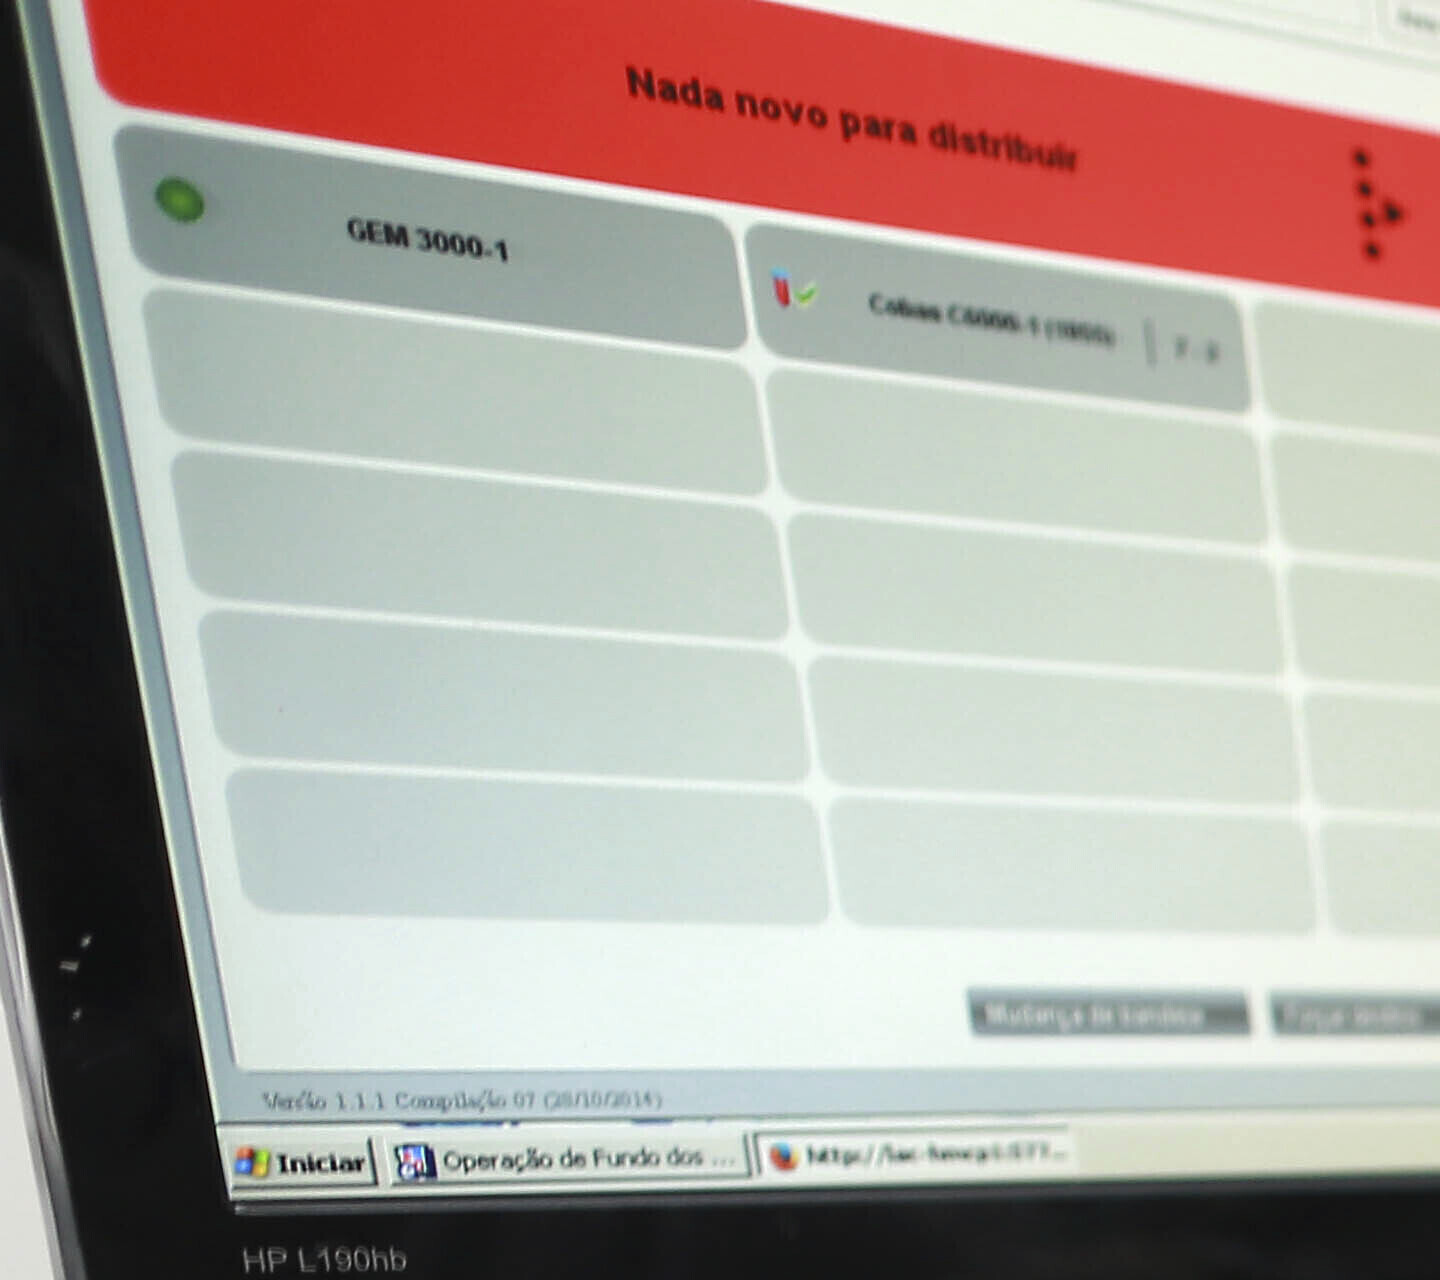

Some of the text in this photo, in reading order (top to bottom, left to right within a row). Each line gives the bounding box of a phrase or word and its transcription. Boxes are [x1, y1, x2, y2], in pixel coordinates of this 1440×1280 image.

[626, 66, 1078, 173] Nada novo para distribuir
[347, 217, 508, 263] GEM 3000-1
[336, 1089, 385, 1111] 1.1.1
[395, 1088, 507, 1113] Compilação
[278, 1151, 365, 1174] Iniciar
[443, 1147, 553, 1174] Operação
[560, 1144, 587, 1168] de
[592, 1145, 660, 1168] Fundo
[666, 1145, 704, 1167] dos
[242, 1244, 408, 1274] HP L190hb
